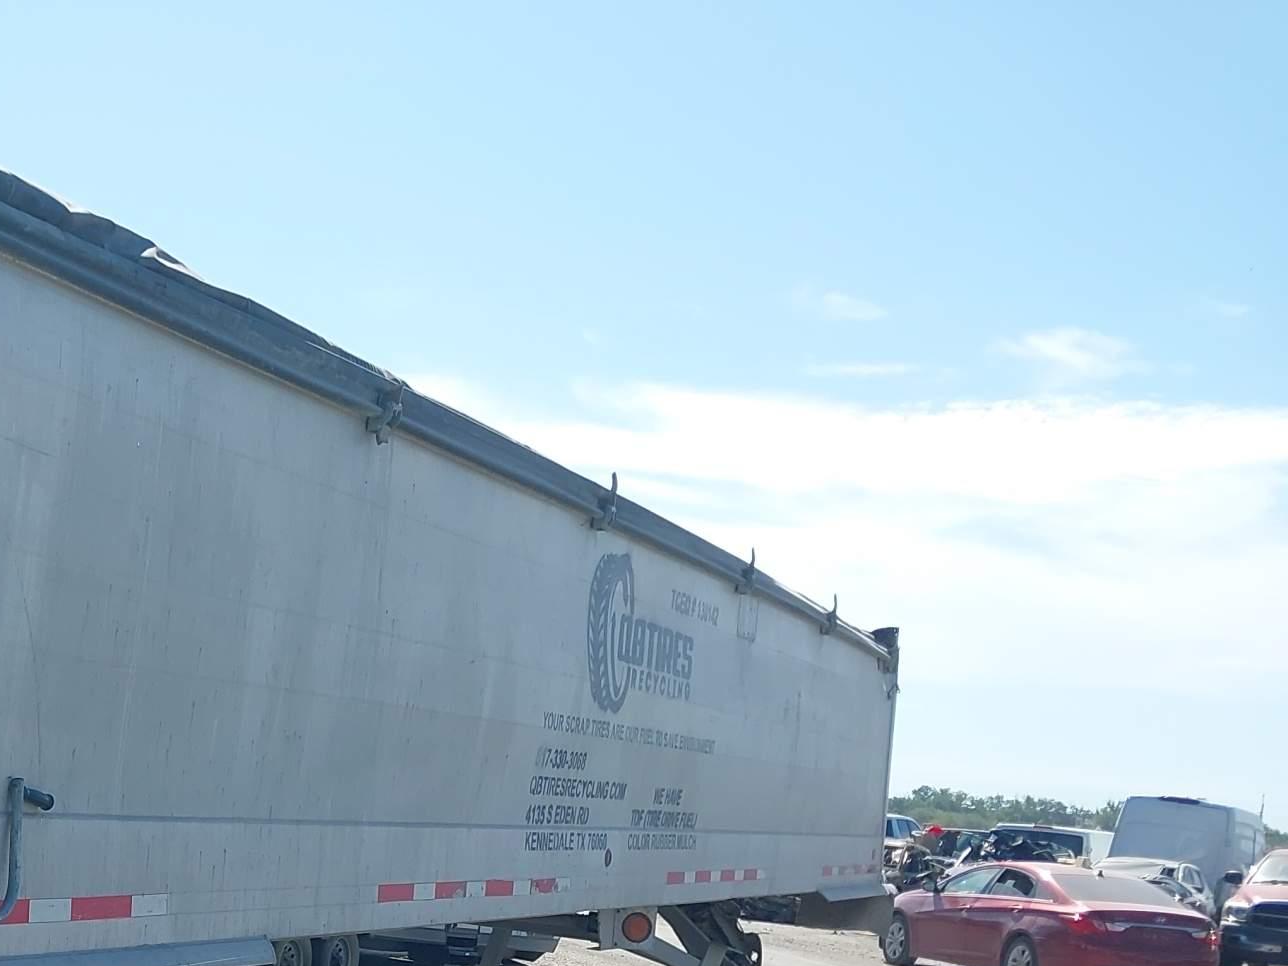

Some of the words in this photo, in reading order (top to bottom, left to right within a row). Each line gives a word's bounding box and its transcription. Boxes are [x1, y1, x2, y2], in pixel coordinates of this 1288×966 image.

[630, 667, 690, 701] RECYCLING
[543, 712, 564, 731] YOUR
[565, 716, 590, 735] SCRAP
[590, 719, 611, 738] TIRES
[611, 724, 625, 741] ARE
[653, 788, 665, 805] WE
[664, 789, 683, 806] HAVE
[525, 805, 546, 824] 4135
[546, 804, 554, 824] S
[554, 805, 577, 825] EDEN
[576, 806, 590, 825] RD
[524, 831, 574, 851] KENNEDALE
[576, 832, 586, 850] TX
[627, 833, 650, 850] COLOR
